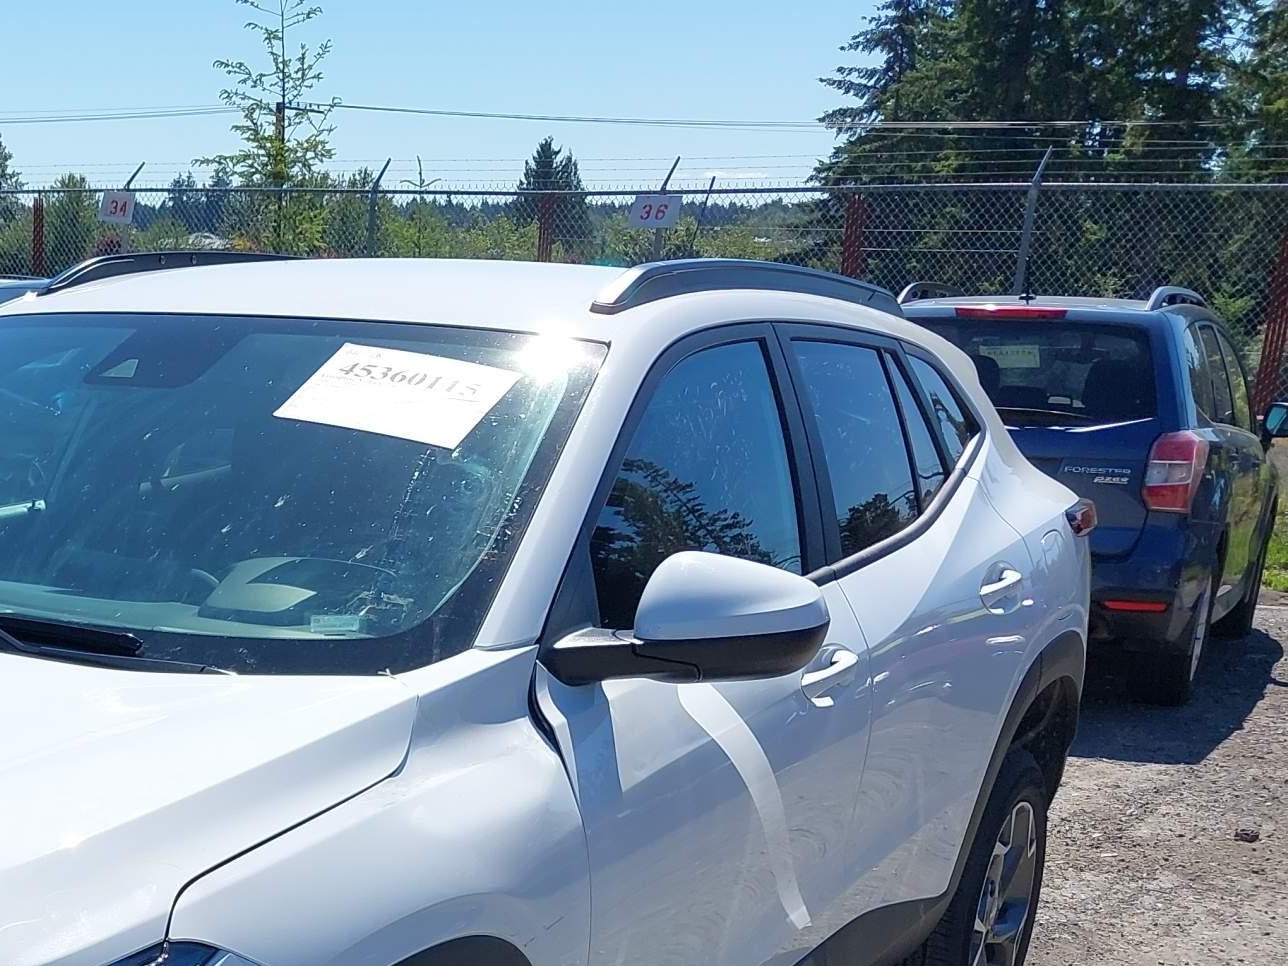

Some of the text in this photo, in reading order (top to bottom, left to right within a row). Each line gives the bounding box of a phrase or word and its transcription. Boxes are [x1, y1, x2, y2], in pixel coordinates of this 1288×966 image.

[109, 199, 128, 217] 34
[640, 203, 669, 221] 36
[338, 362, 481, 395] 45360115
[1064, 466, 1131, 474] FORESTER
